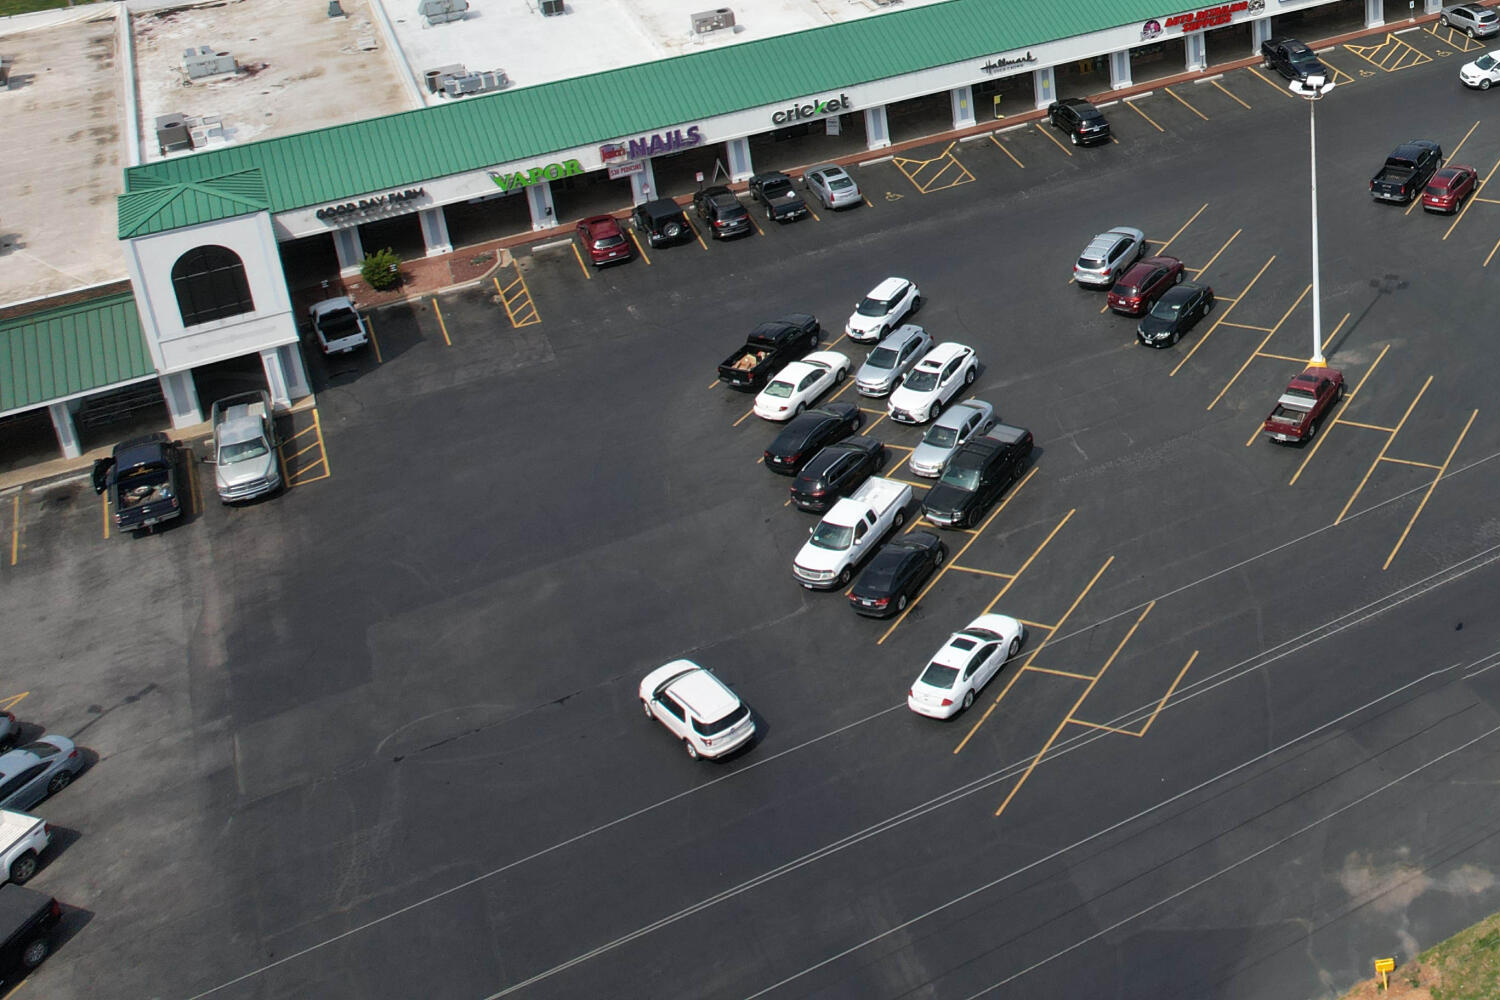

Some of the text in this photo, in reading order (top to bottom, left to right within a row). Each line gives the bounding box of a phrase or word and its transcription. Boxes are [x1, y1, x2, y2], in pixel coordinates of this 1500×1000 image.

[1164, 1, 1248, 28] AUTO DETAILING
[1182, 13, 1232, 33] SUPPLIES
[980, 51, 1037, 75] Hallmark
[772, 93, 849, 124] cricket
[628, 125, 700, 160] NAILS
[488, 158, 584, 191] VAPOR
[316, 187, 424, 220] GOOD DAY FARM
